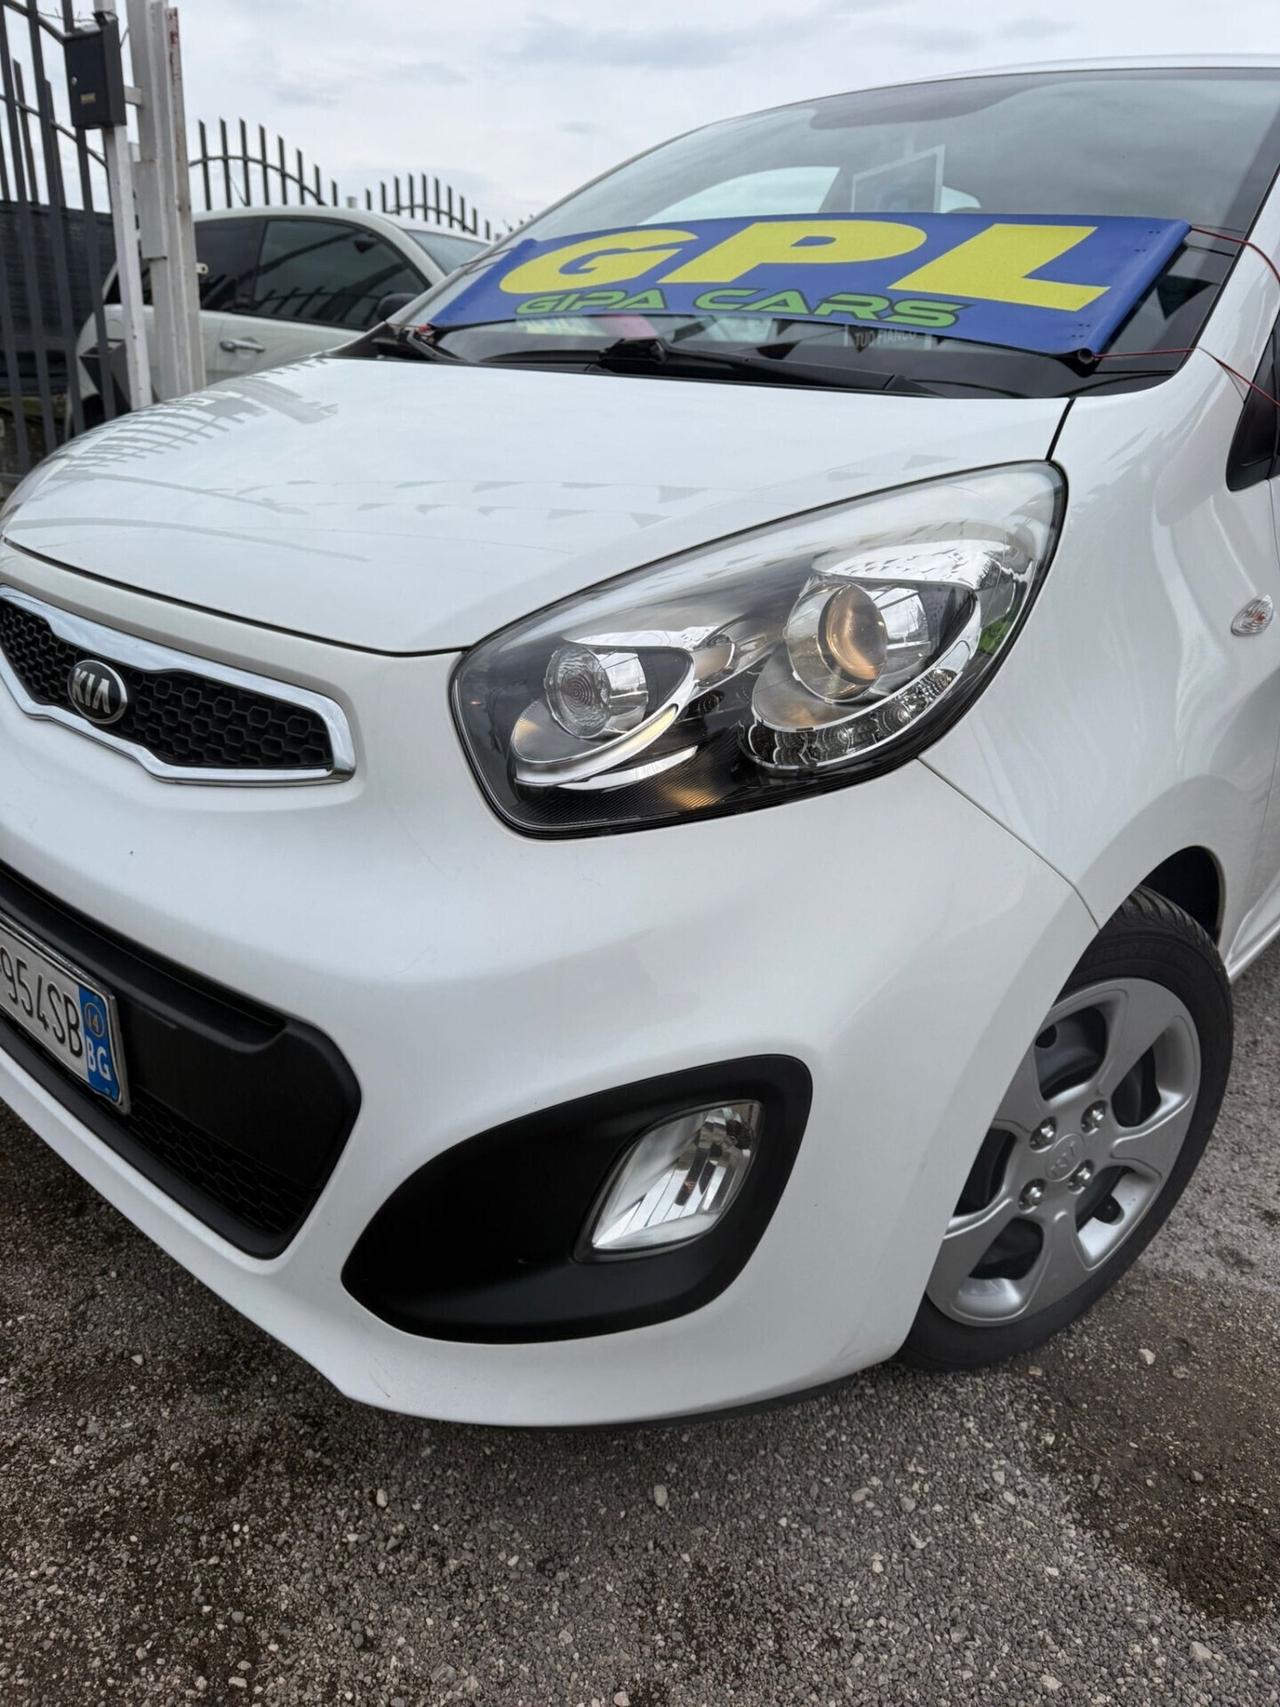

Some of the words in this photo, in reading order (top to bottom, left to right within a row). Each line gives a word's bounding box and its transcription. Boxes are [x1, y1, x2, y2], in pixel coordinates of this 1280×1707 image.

[499, 220, 1111, 312] GPL
[515, 287, 667, 315] GIPA
[693, 288, 972, 329] CARS
[72, 667, 111, 714] KIA
[0, 946, 83, 1058] 954SB
[86, 1036, 112, 1082] BG
